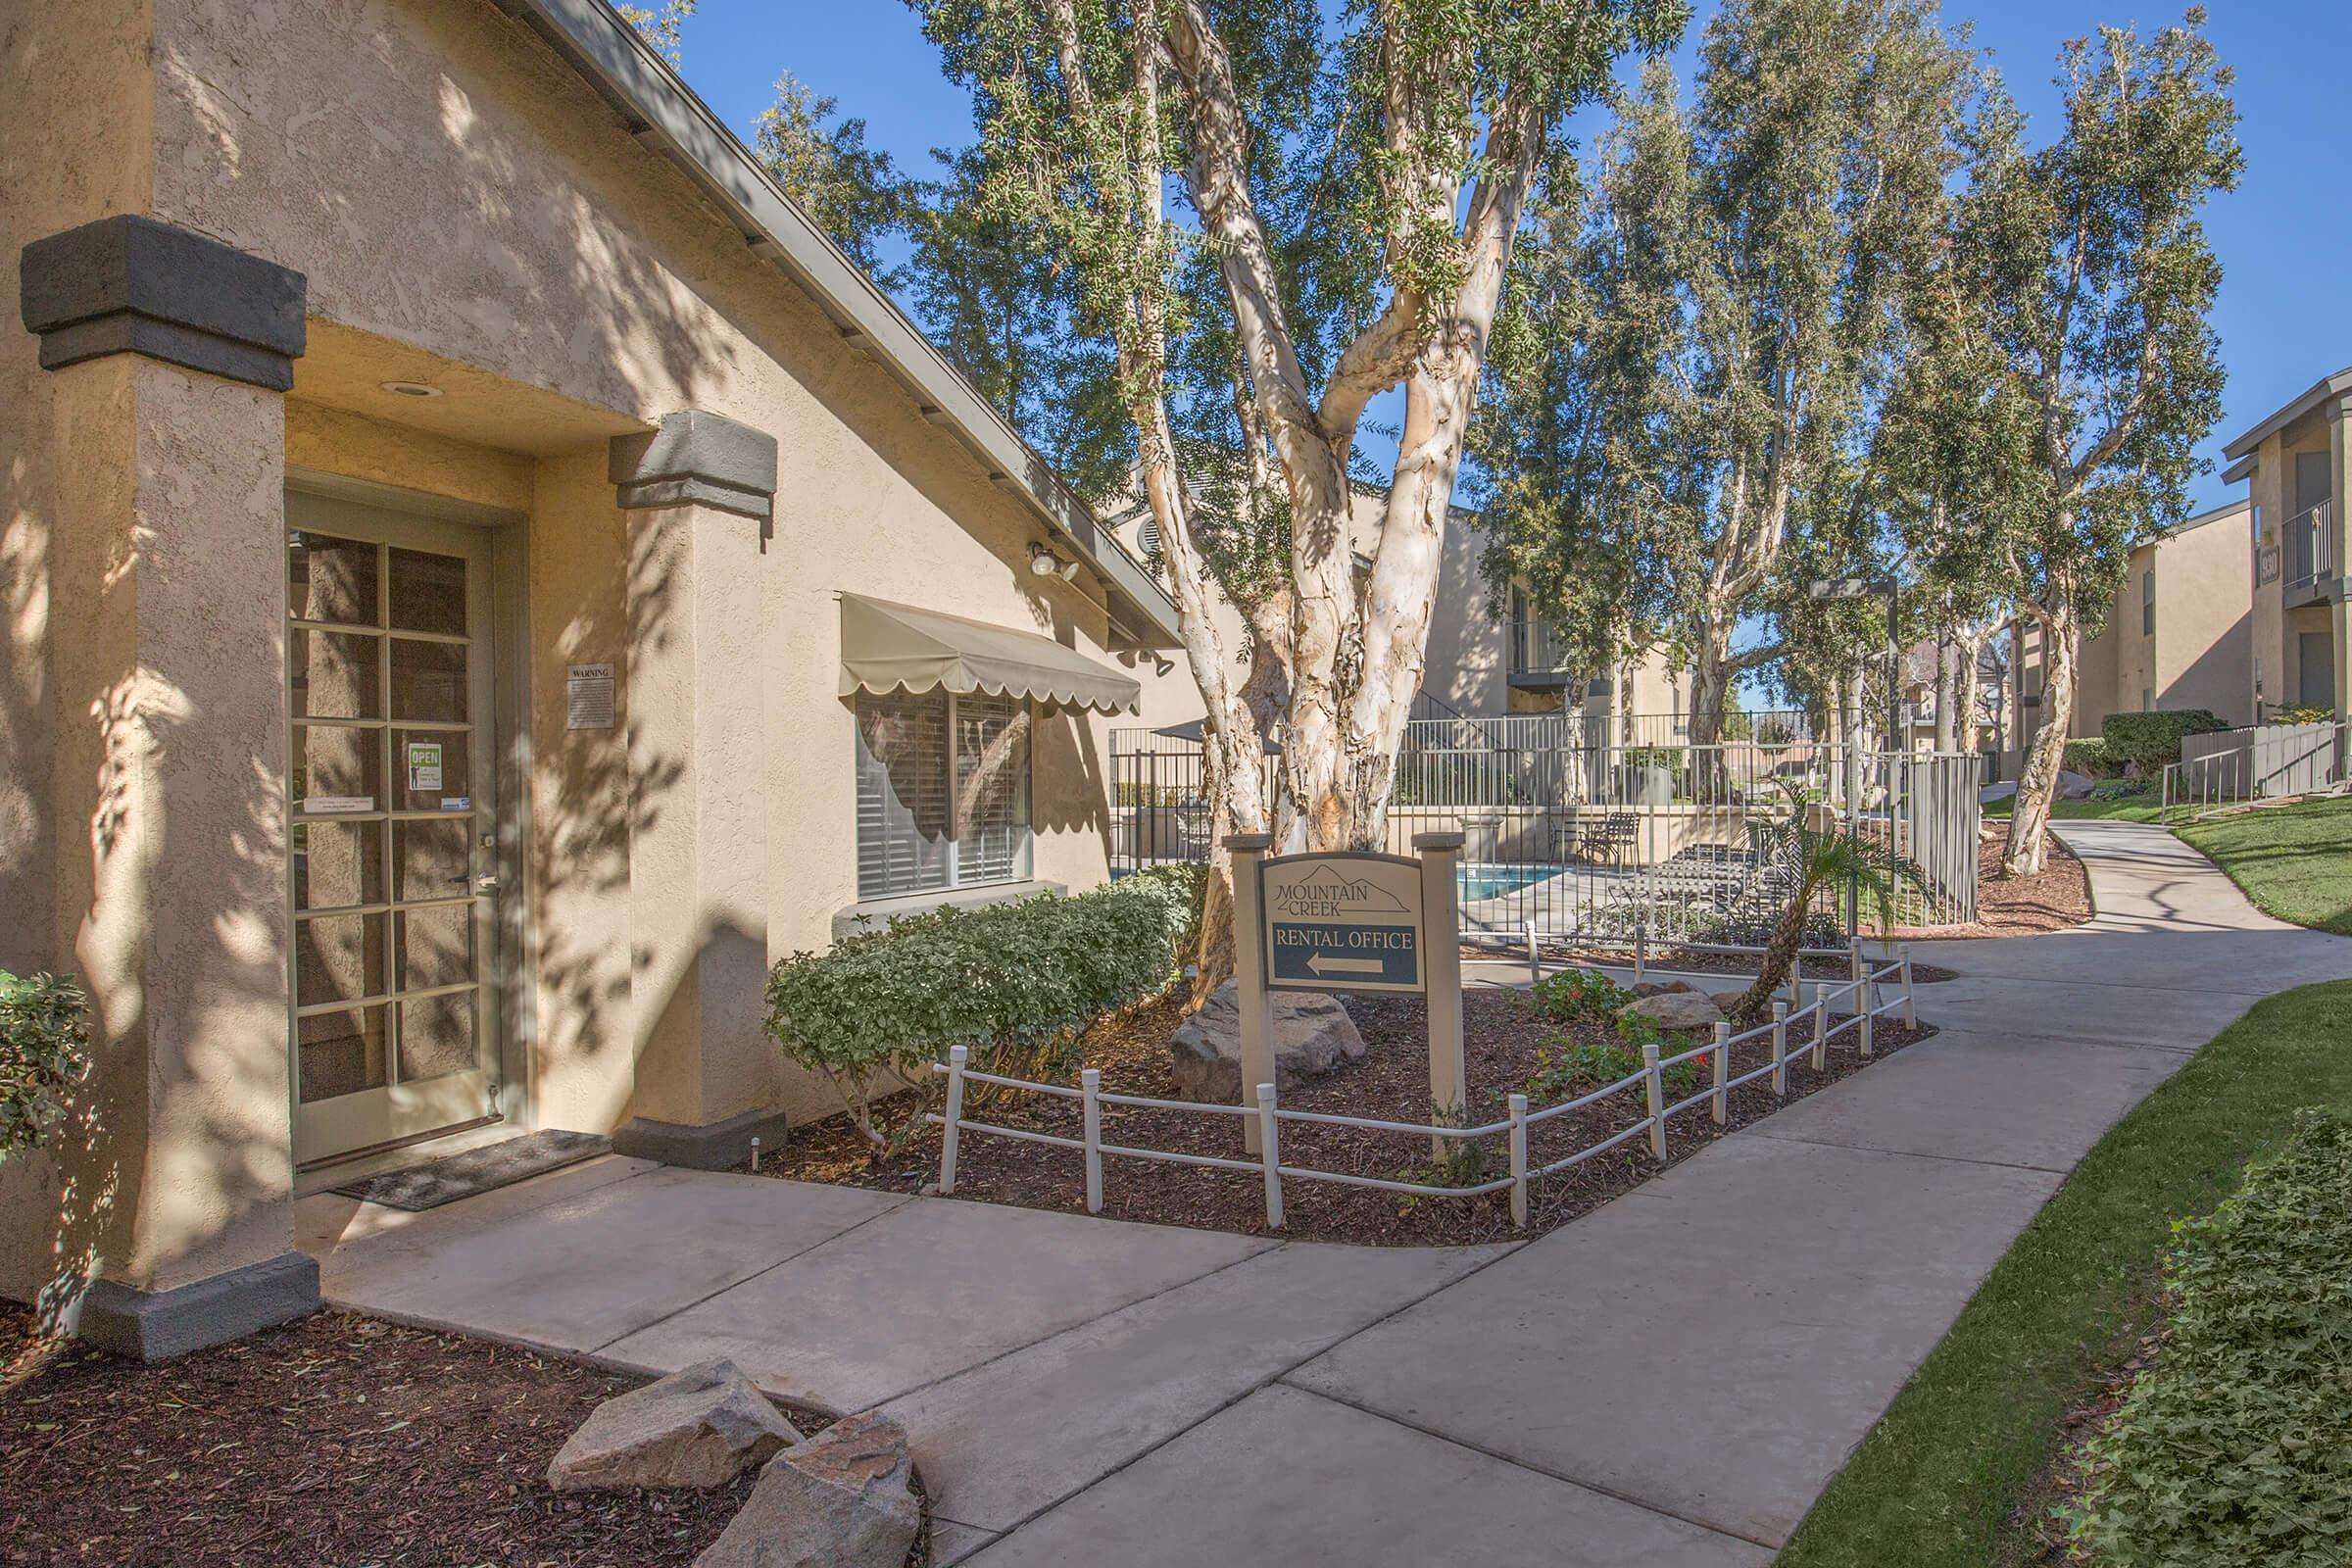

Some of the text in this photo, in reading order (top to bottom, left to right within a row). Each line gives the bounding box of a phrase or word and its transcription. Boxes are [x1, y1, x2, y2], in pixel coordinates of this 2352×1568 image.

[2262, 553, 2278, 579] 930
[572, 668, 609, 677] WARNING
[412, 751, 438, 763] OPEN
[1273, 885, 1368, 902] MOUNTAIN
[1288, 902, 1342, 916] CREEK
[1276, 929, 1413, 950] RENTAL OFFICE
